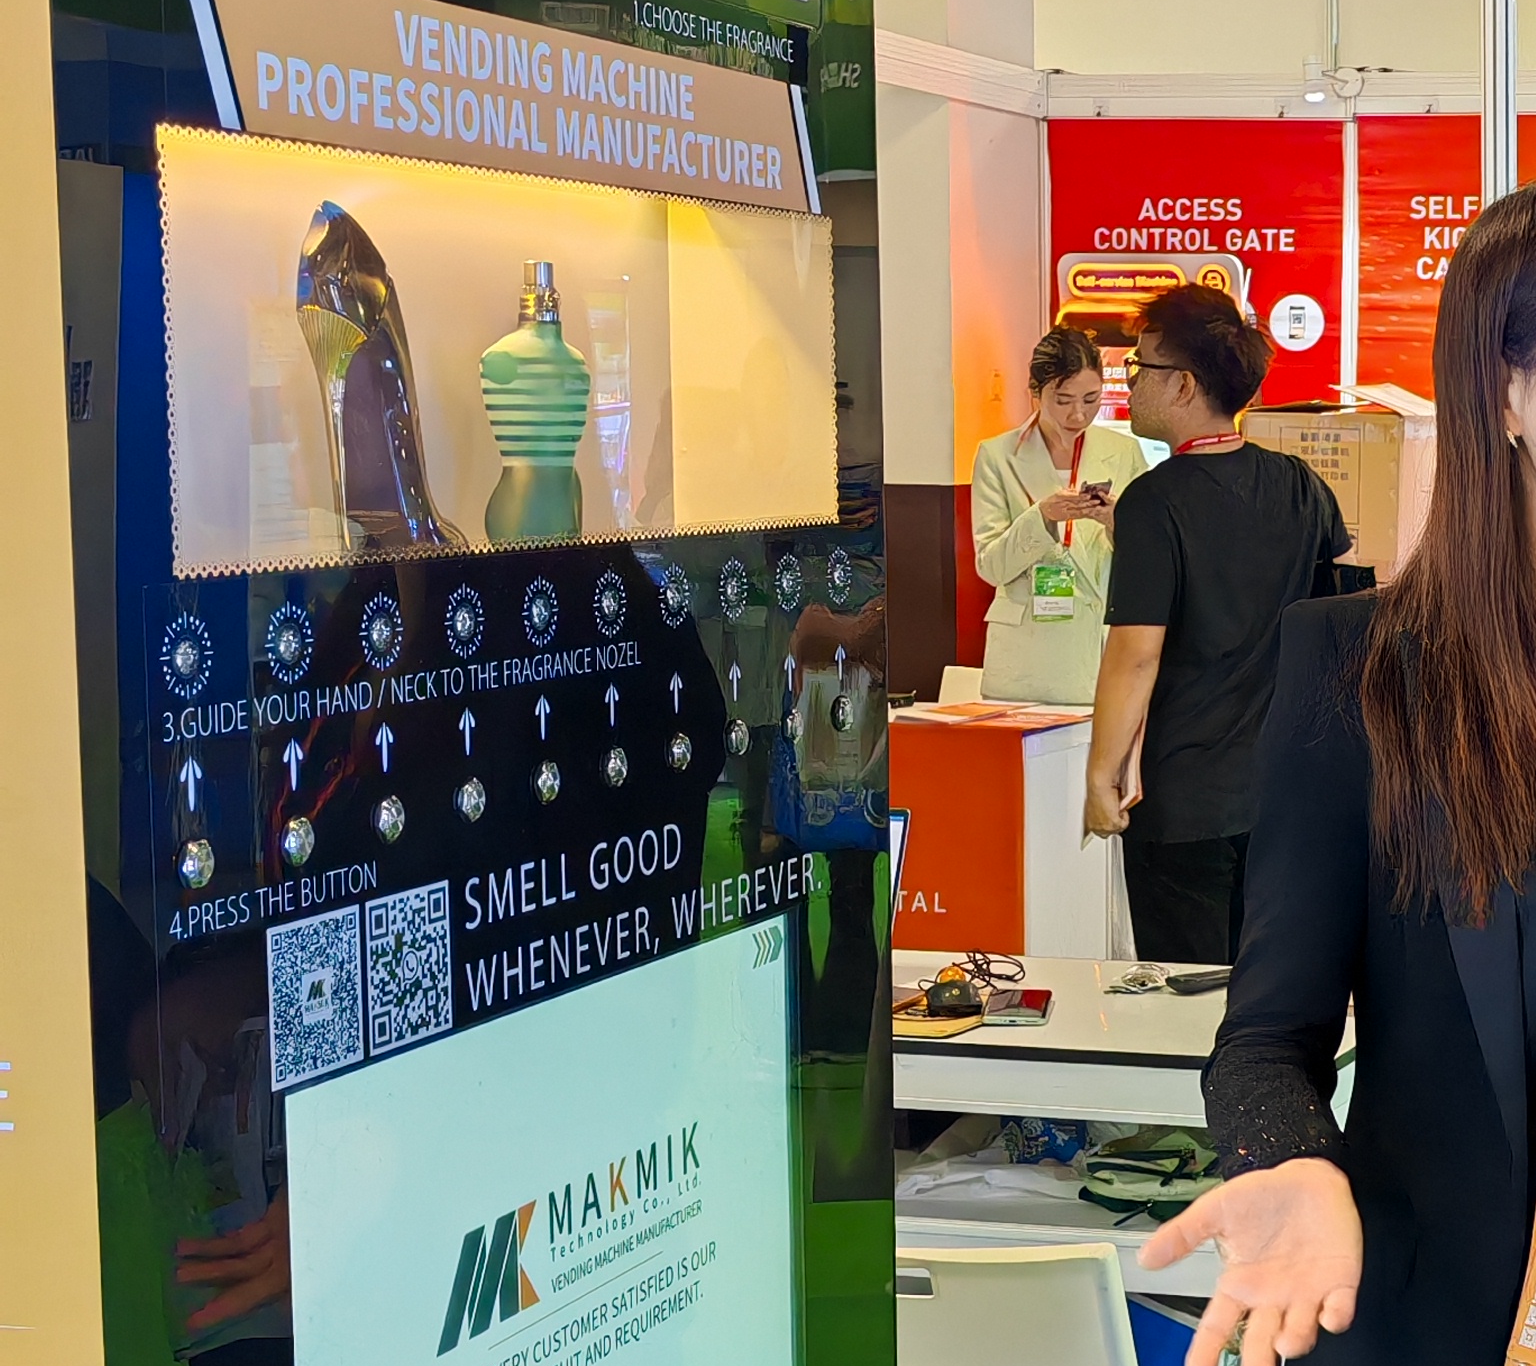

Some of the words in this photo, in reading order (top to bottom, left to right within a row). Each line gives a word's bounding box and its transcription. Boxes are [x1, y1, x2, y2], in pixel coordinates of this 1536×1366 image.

[394, 10, 553, 94] VENDING
[562, 49, 695, 122] MACHINE
[632, 0, 697, 39] 1.CHOOSE
[700, 16, 723, 46] THE
[726, 23, 795, 63] FRAGRANCE
[256, 50, 547, 161] PROFESSIONAL
[556, 109, 782, 190] MANUFACTURER
[1094, 227, 1218, 252] CONTROL
[1226, 227, 1295, 252] GATE
[1138, 198, 1242, 222] ACCESS
[162, 699, 248, 744] 3.GUIDE
[253, 695, 311, 727] YOUR
[317, 681, 372, 718] HAND
[391, 670, 437, 706] NECK
[440, 666, 465, 696] TO
[468, 662, 499, 692] THE
[503, 649, 593, 686] FRAGRANCE
[596, 641, 641, 672] NOZEL
[169, 890, 250, 941] 4.PRESS
[256, 882, 294, 918] THE
[301, 861, 378, 908] BUTTON
[465, 853, 575, 930] SMELL
[589, 823, 682, 891] GOOD
[467, 905, 660, 1011] WHENEVER,
[671, 853, 823, 939] WHEREVER.
[548, 1121, 700, 1244] MAKMIK
[550, 1209, 636, 1263] Technology
[551, 1257, 593, 1294] VENDING
[594, 1237, 635, 1271] MACHINE
[636, 1200, 703, 1249] MANUFACTURER
[533, 1303, 608, 1365] CUSTOMER
[612, 1265, 674, 1319] SATISFIED
[677, 1256, 689, 1279] IS
[691, 1241, 717, 1272] OUR
[615, 1281, 704, 1351] REQUIREMENT.
